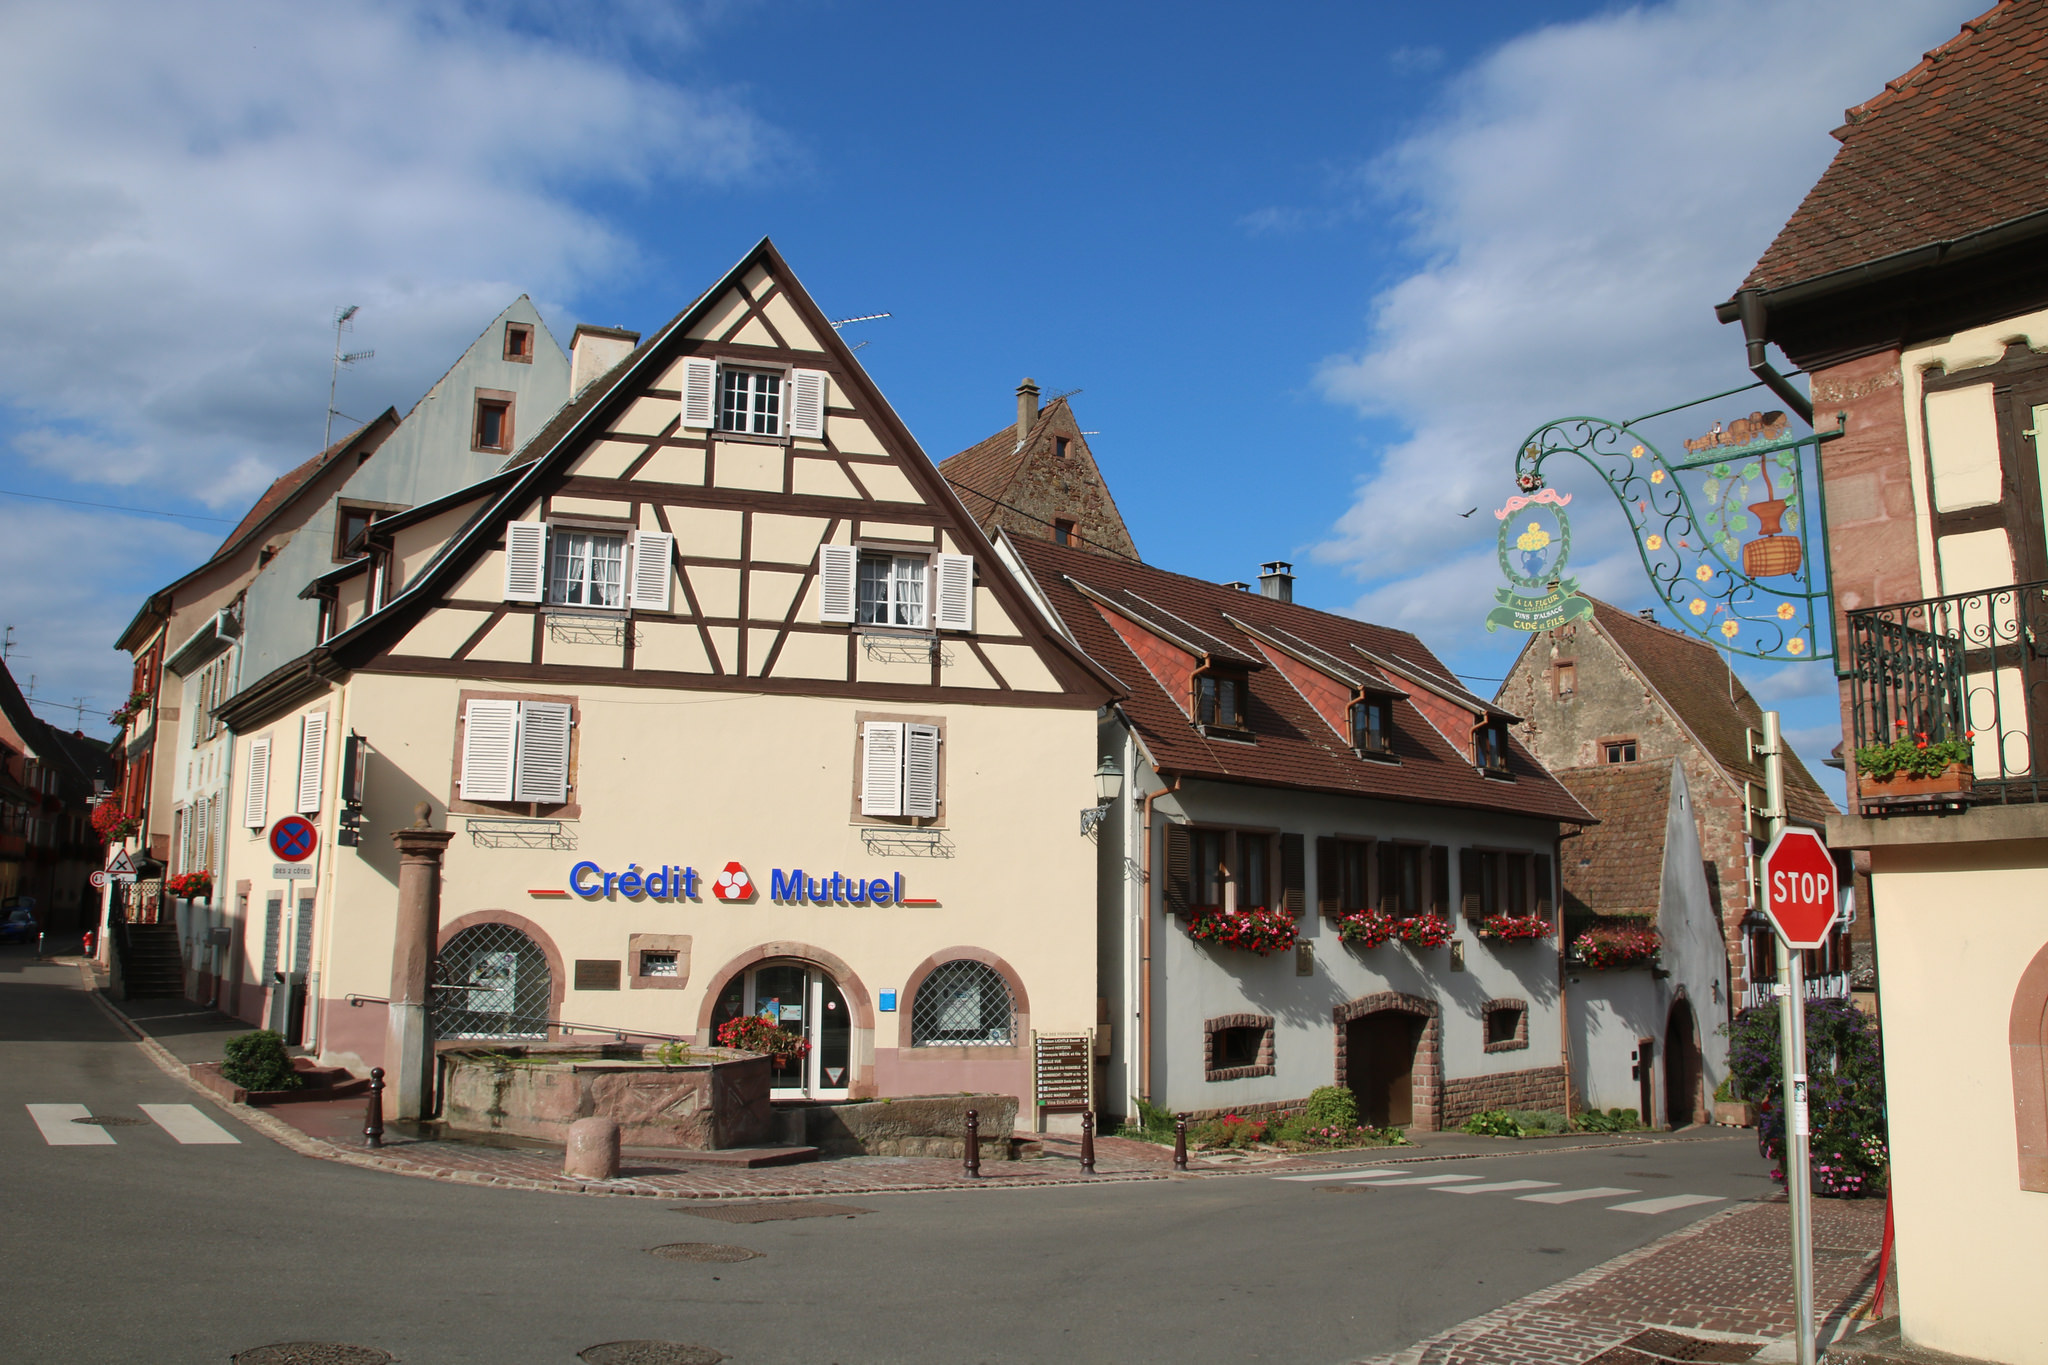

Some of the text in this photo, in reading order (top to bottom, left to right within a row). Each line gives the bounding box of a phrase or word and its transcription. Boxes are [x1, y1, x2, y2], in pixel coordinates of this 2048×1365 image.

[1535, 594, 1560, 607] FLEUR
[1514, 611, 1530, 620] VINS
[1533, 605, 1564, 620] D'ALSACE
[1546, 615, 1565, 628] FILS
[569, 861, 900, 904] Crédit Mutuel
[1773, 870, 1830, 905] STOP
